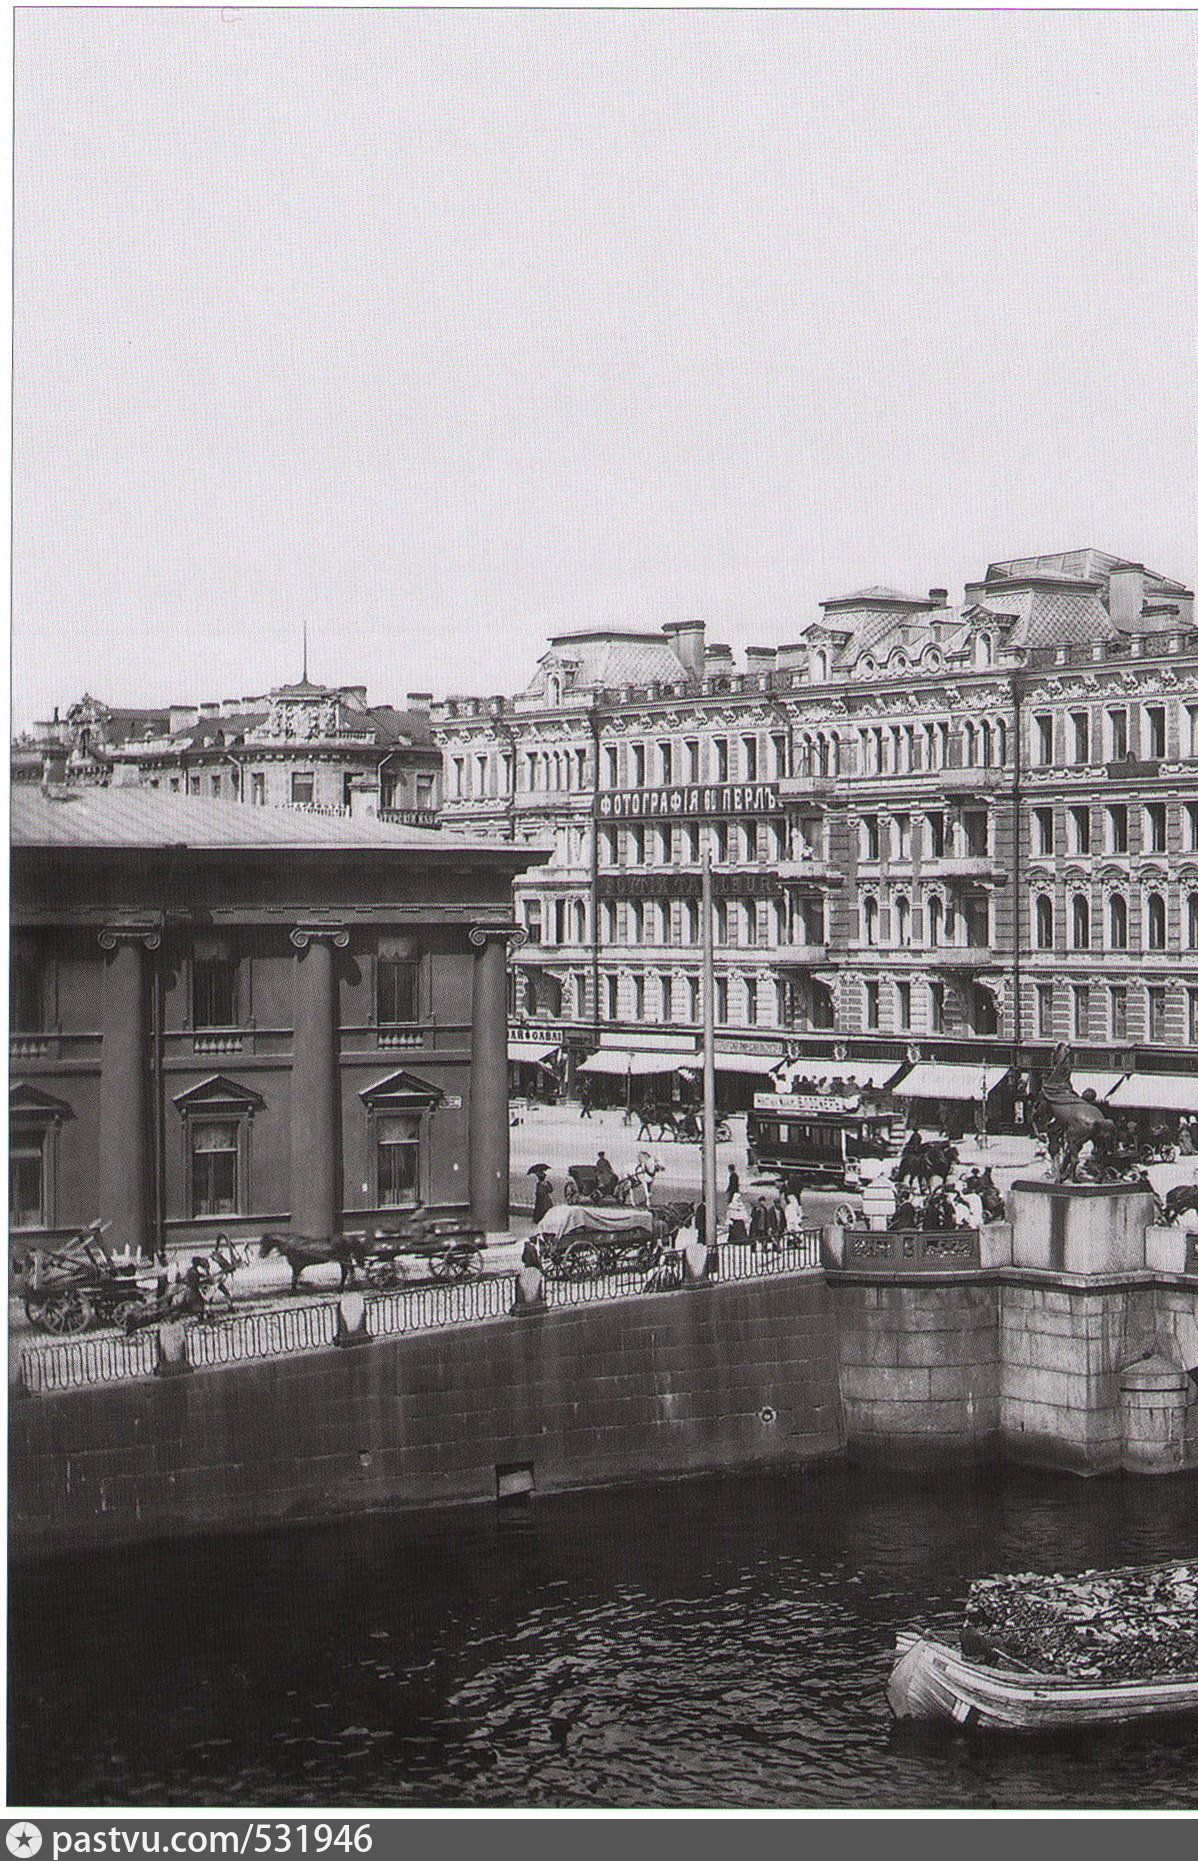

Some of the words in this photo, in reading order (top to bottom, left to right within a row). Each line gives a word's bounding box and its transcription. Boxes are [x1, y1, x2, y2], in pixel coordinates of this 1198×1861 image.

[600, 789, 699, 815] ФОТОГРАФІЯ
[722, 786, 776, 811] ПЕРЛЪ
[673, 875, 772, 895] TALLEUR
